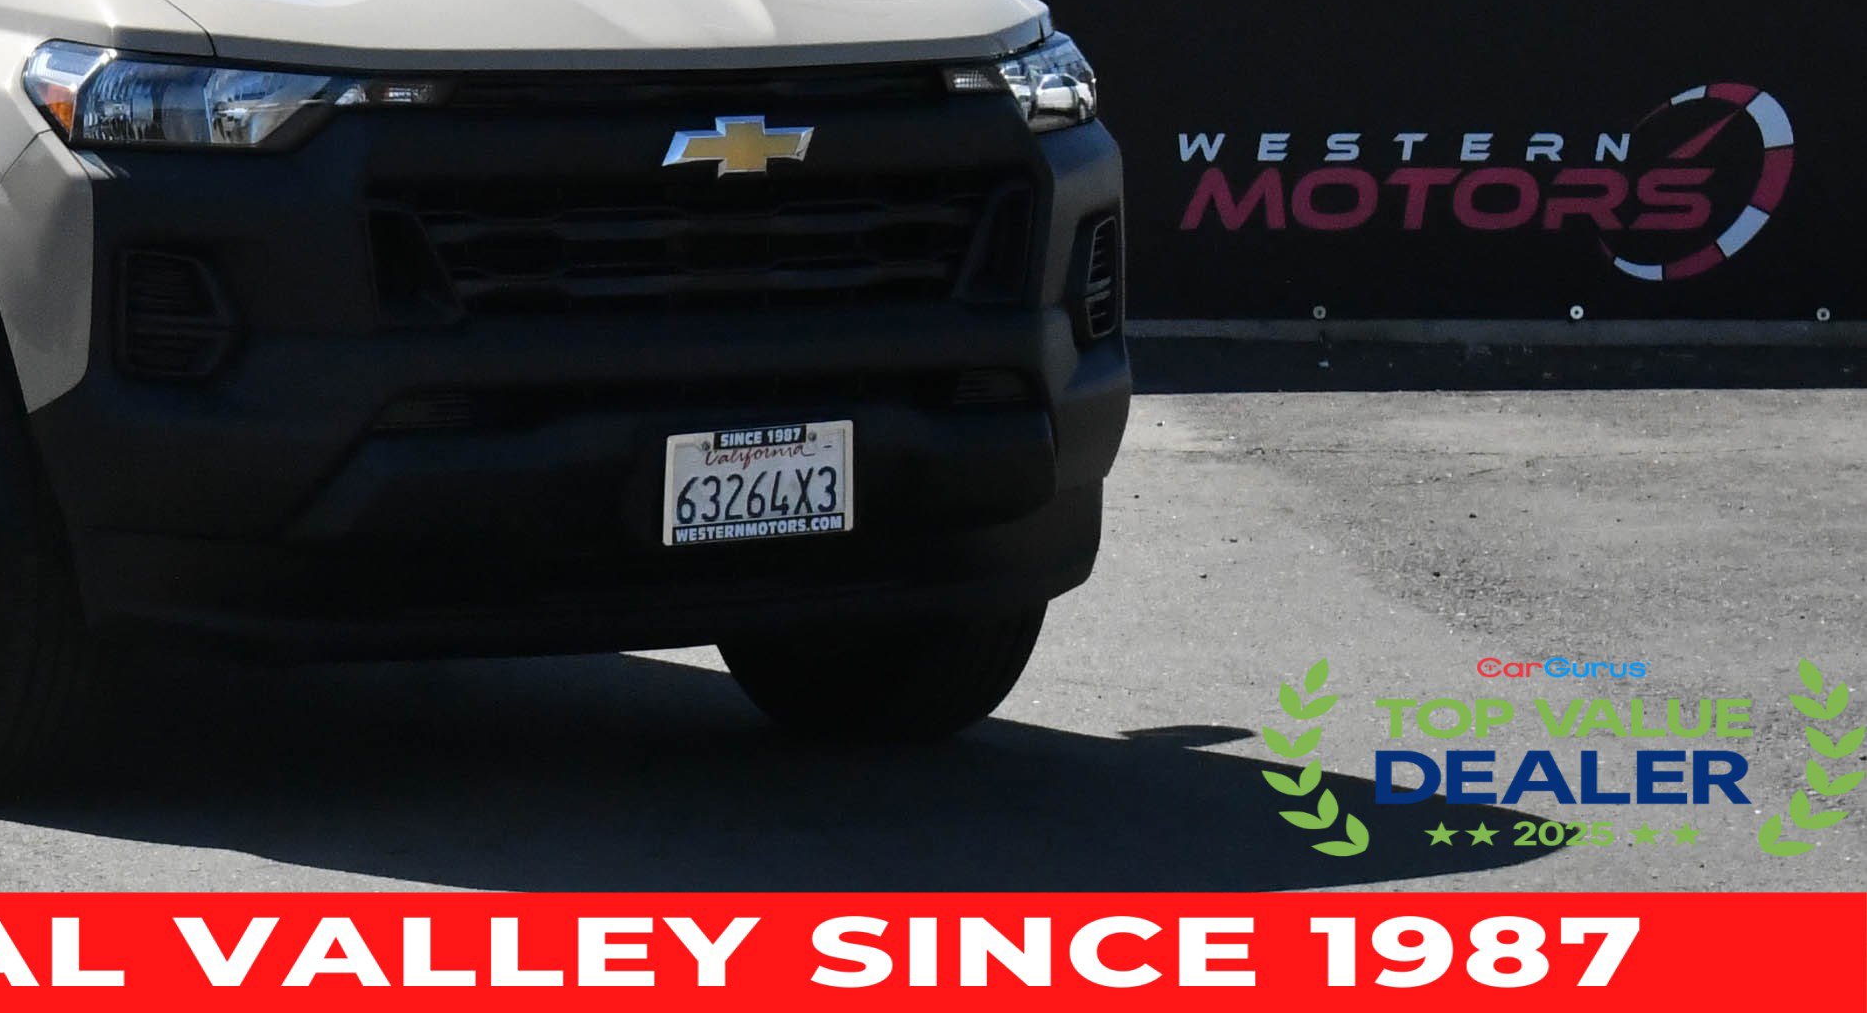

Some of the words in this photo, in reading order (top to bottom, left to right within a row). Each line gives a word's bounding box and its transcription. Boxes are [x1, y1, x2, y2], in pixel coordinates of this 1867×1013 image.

[1179, 133, 1630, 162] WESTERN
[1183, 167, 1713, 230] MOTORS
[719, 431, 764, 448] SINCE
[767, 427, 802, 444] 1987
[704, 443, 815, 470] California
[675, 465, 838, 524] 63264X3
[675, 514, 843, 543] WESTERNMOTORS.COM
